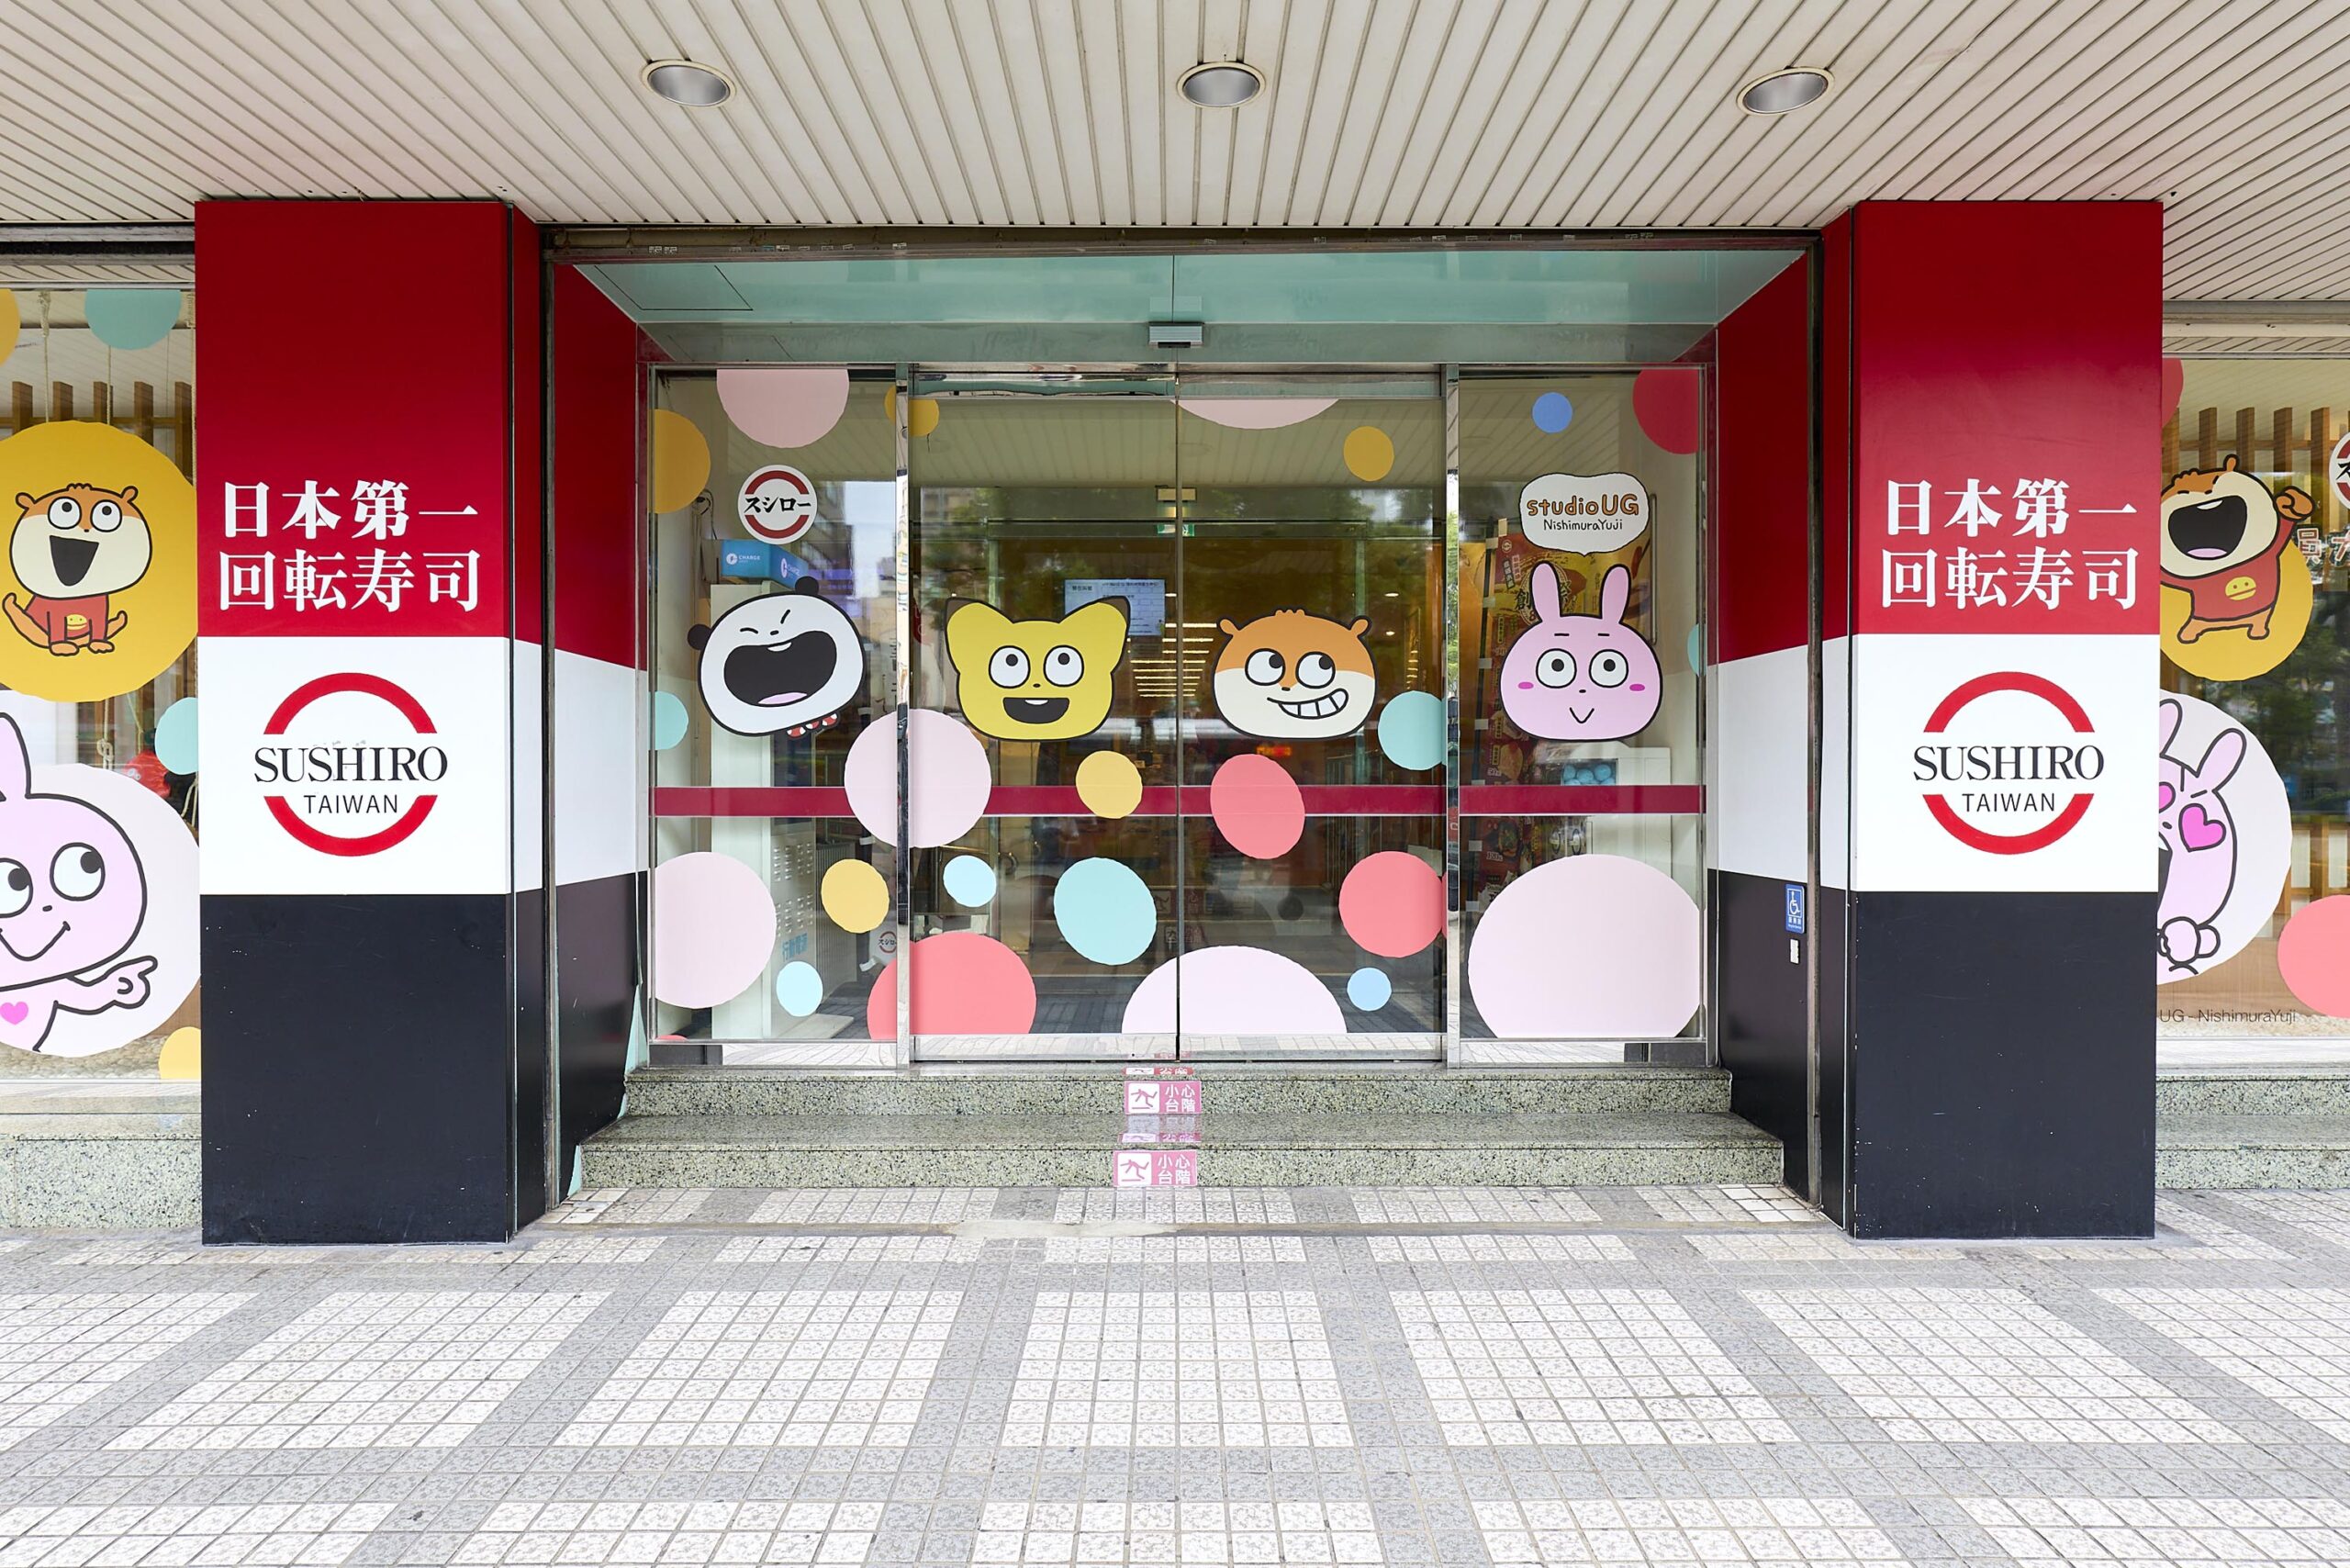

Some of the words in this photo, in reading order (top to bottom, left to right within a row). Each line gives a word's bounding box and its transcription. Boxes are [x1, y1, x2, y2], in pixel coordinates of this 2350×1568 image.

[223, 479, 478, 540] 日本第一
[744, 496, 811, 513] スシロー
[1886, 477, 2137, 538] 日本第一
[1543, 519, 1623, 531] NishimuraYuji
[219, 548, 480, 612] 回転寿司
[1882, 546, 2139, 610] 回転寿司
[254, 745, 448, 783] SUSHIRO
[1913, 745, 2104, 781] SUSHIRO
[303, 793, 397, 814] TAIWAN
[1962, 792, 2055, 812] TAIWAN
[878, 937, 897, 946] スシロ
[2198, 1008, 2296, 1025] NishimuraYuji
[1165, 1084, 1195, 1098] 小心
[1165, 1099, 1196, 1113] 台階
[1158, 1154, 1191, 1169] 小心
[1158, 1170, 1191, 1185] 台階
